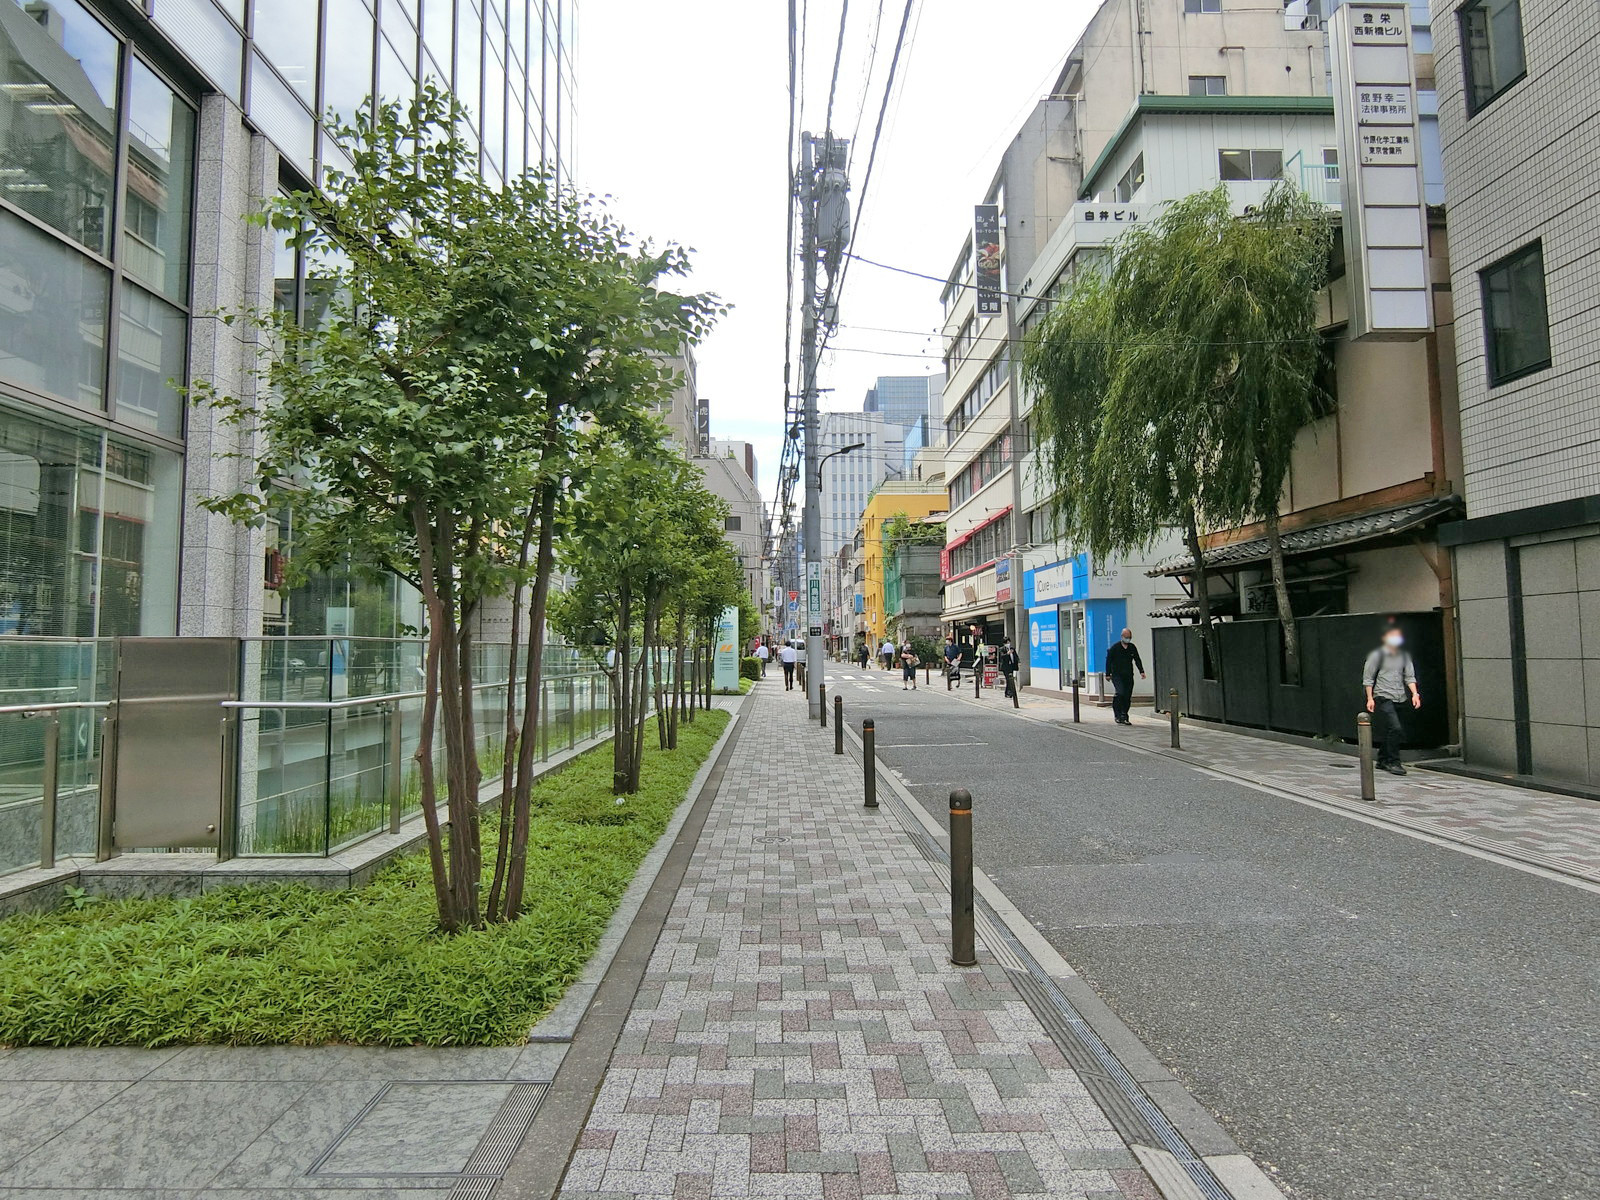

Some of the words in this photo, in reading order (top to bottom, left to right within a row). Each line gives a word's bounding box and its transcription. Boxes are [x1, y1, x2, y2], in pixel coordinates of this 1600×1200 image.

[1354, 26, 1402, 36] 西新橋ビル
[1361, 104, 1407, 114] 法律事務所
[1369, 147, 1402, 155] 東京営業所
[1084, 210, 1138, 221] 白井ビル
